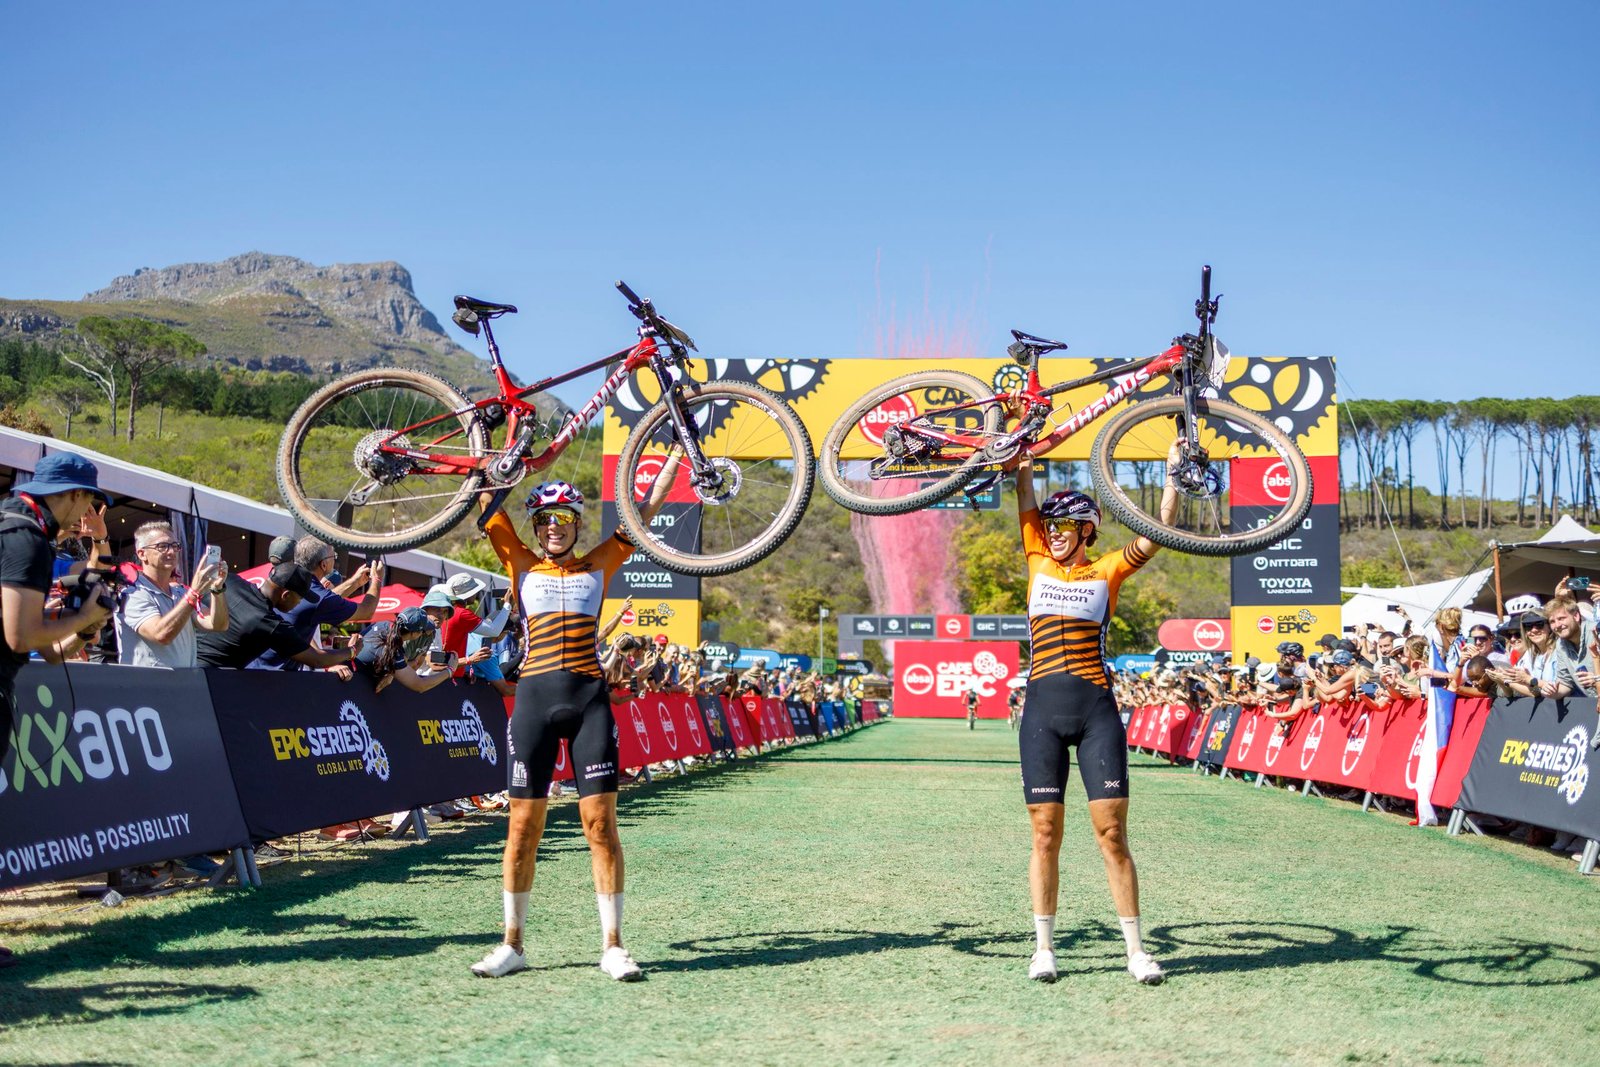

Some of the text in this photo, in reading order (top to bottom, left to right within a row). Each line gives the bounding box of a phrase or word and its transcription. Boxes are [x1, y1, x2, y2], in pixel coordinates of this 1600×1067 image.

[867, 409, 910, 424] absa
[684, 438, 697, 458] SWISS
[1268, 474, 1291, 487] abs
[623, 572, 672, 582] TOYOTA
[1259, 578, 1312, 588] TOYOTA
[1040, 592, 1088, 603] maxon
[638, 615, 668, 626] EPIC
[976, 623, 996, 631] GIC
[1278, 622, 1310, 633] EPIC
[1167, 652, 1213, 661] TOYOTA
[936, 662, 973, 675] CAPE
[906, 669, 997, 697] absa EPIC
[417, 720, 444, 745] EPIC
[442, 719, 479, 743] SERIES
[269, 724, 364, 761] EPIC SERIES
[449, 748, 469, 758] GLOBAL
[1499, 739, 1575, 772] EPIC SERIES
[317, 758, 364, 776] GLOBAL MTB
[585, 762, 613, 772] SPIER
[1519, 771, 1560, 788] GLOBAL MTB
[96, 813, 191, 853] POSSIBILITY
